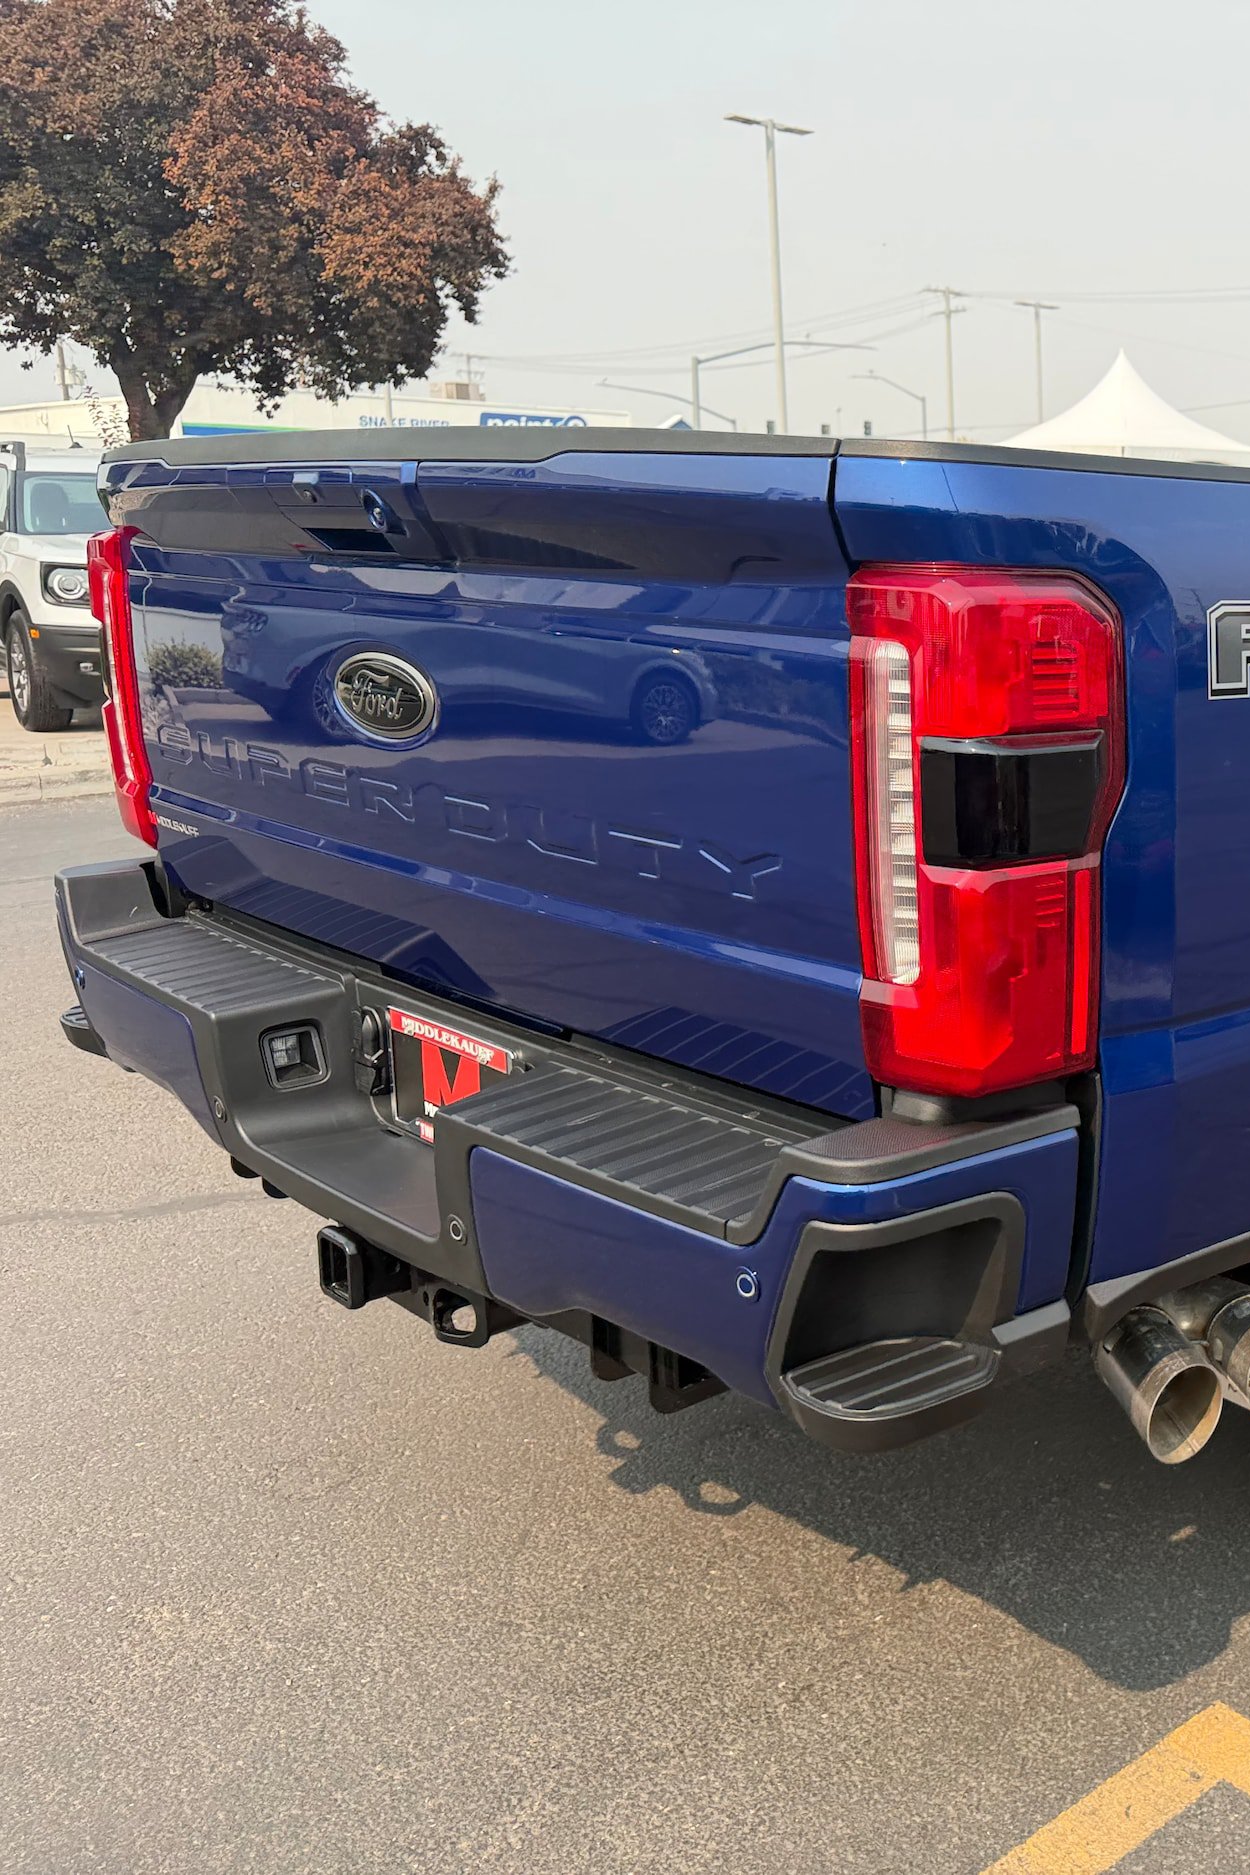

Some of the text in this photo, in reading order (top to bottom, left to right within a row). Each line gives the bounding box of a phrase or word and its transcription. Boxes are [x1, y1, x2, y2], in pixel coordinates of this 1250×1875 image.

[350, 669, 403, 720] Ford
[157, 723, 783, 902] SUPER DUTY
[401, 1016, 494, 1065] MIDDLEKAUFF
